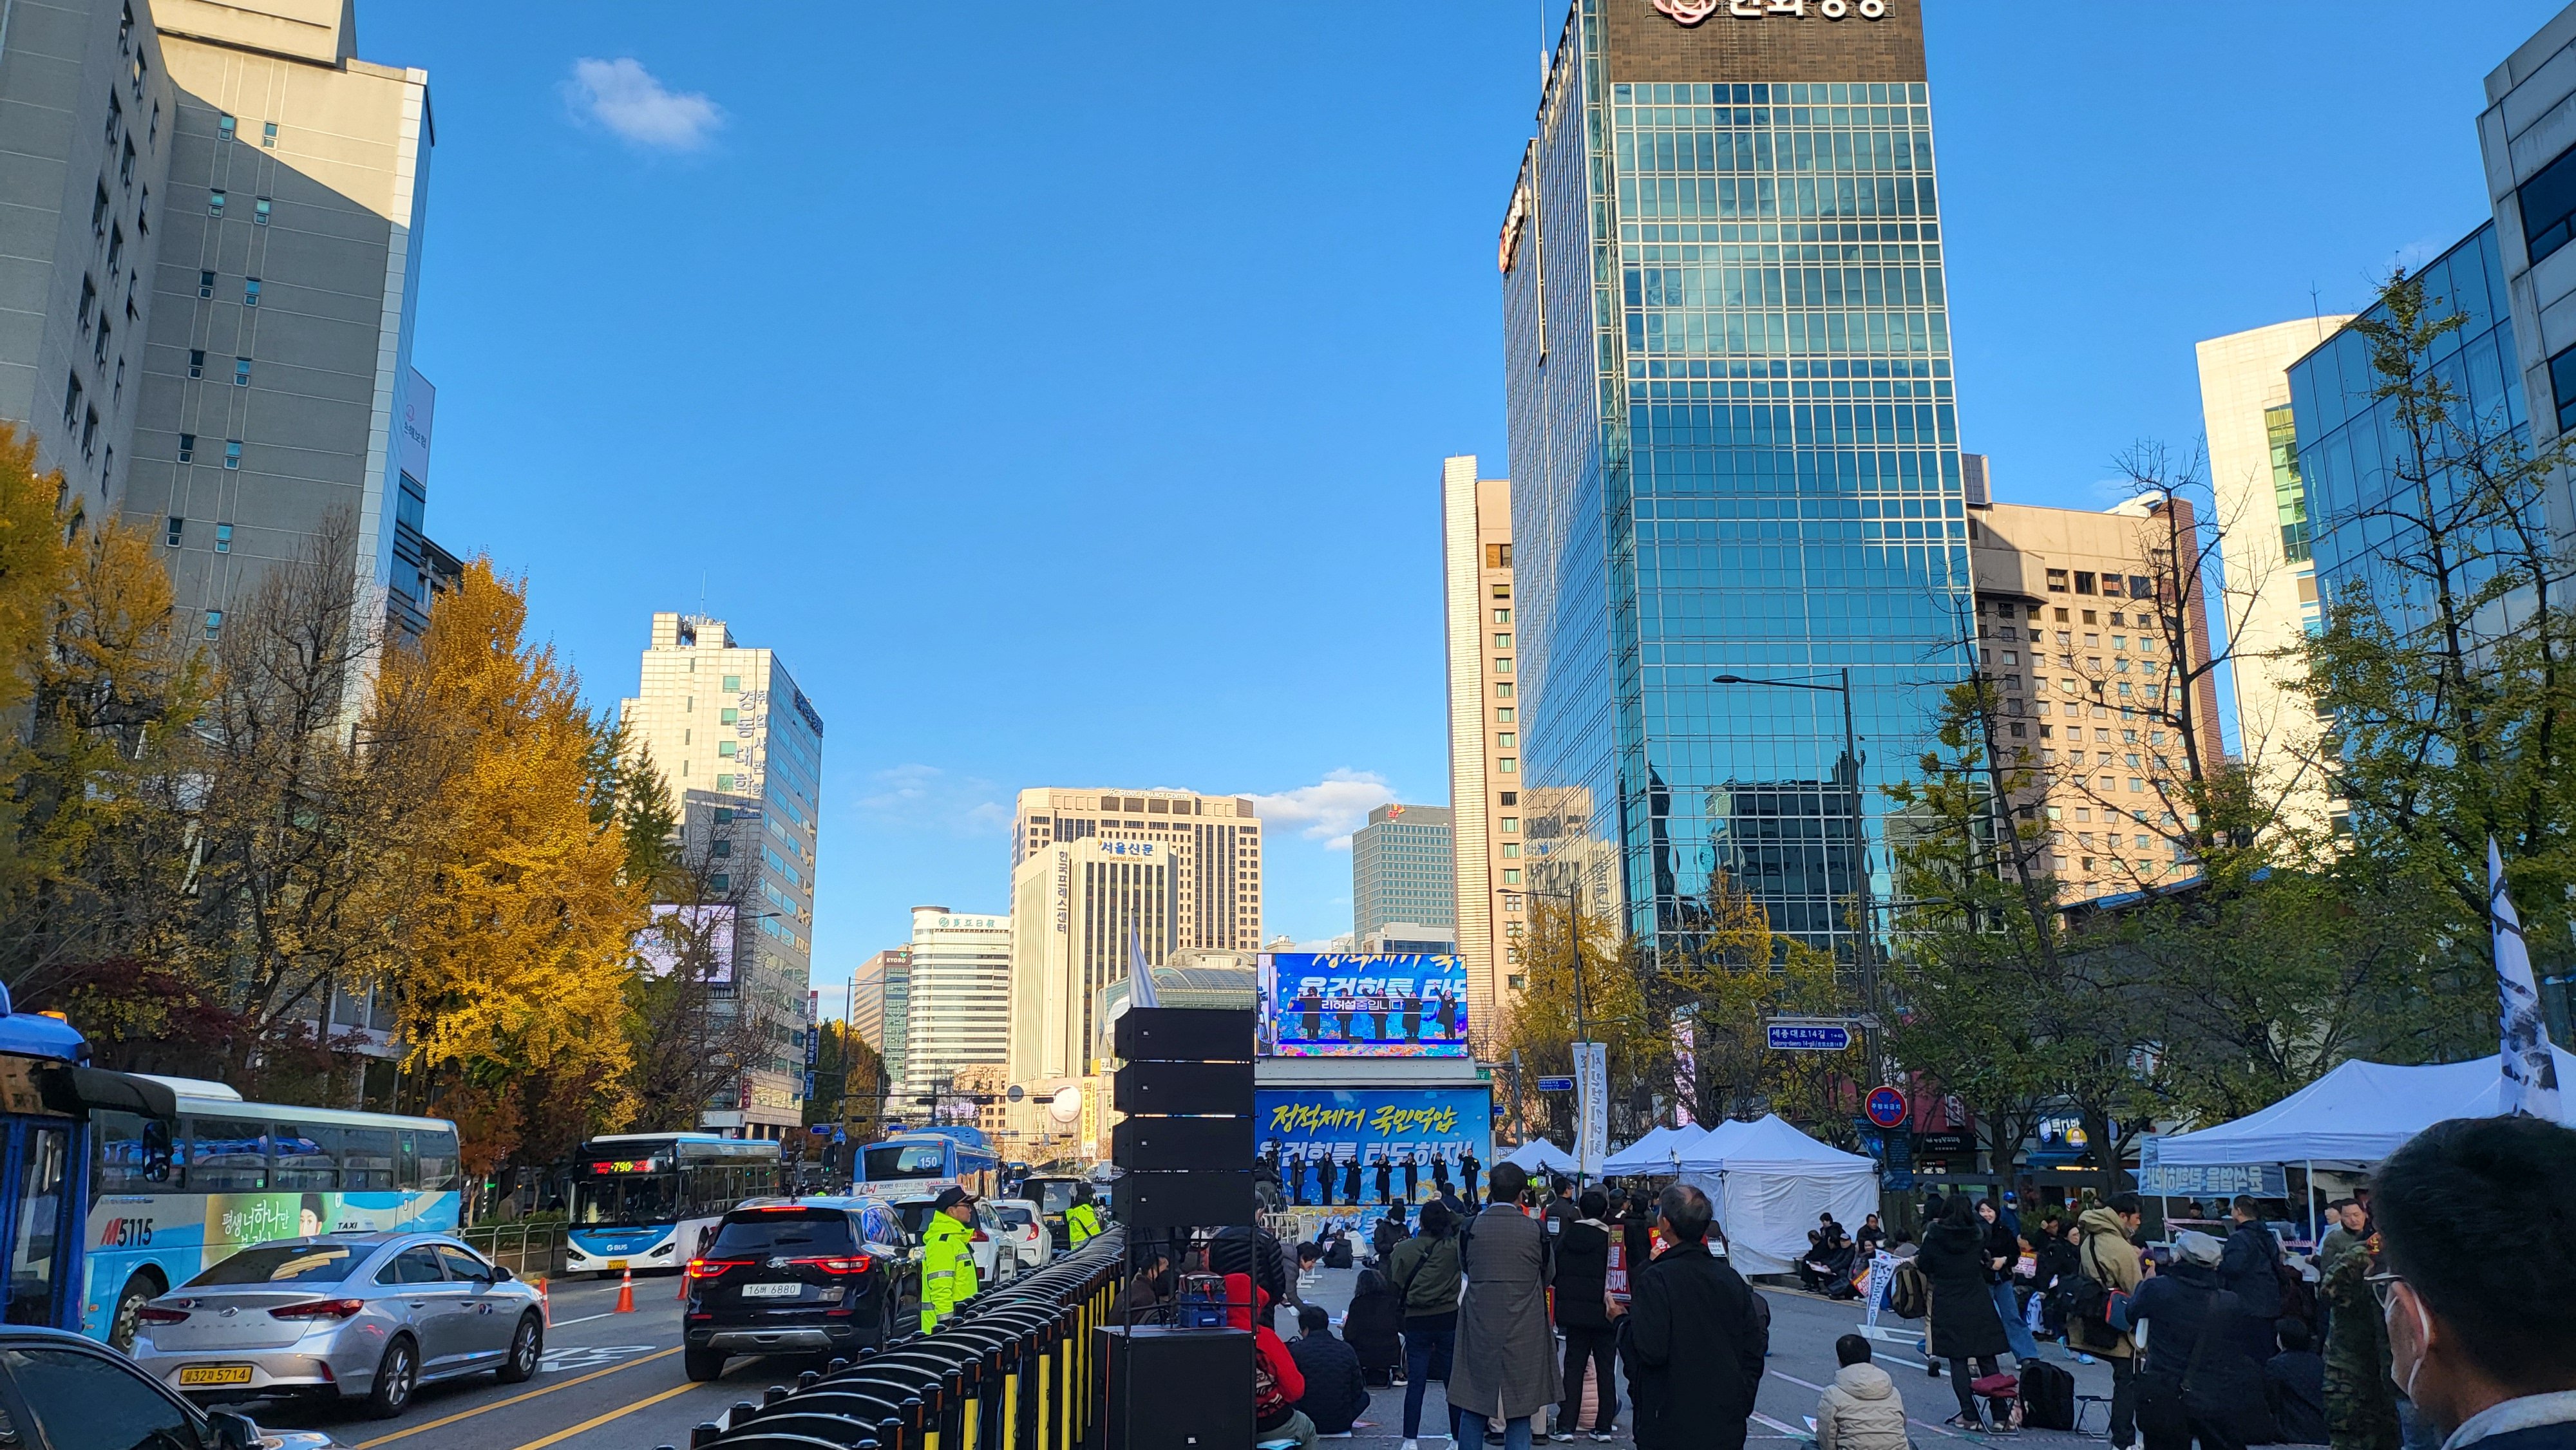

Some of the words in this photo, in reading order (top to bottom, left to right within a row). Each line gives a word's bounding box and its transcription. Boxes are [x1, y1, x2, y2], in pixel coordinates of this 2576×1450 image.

[1101, 842, 1154, 856] 서울신문
[1057, 851, 1068, 935] 한국프레스센터
[809, 1001, 817, 1021] 다이소
[1771, 1029, 1826, 1039] 세종대로14길
[1269, 1103, 1367, 1137] 정적제거
[1369, 1104, 1459, 1138] 국민억압
[919, 1156, 938, 1169] 150
[100, 1216, 154, 1248] M5115
[337, 1221, 358, 1230] TAXI
[770, 1285, 796, 1294] 6880
[216, 1369, 246, 1381] 5714
